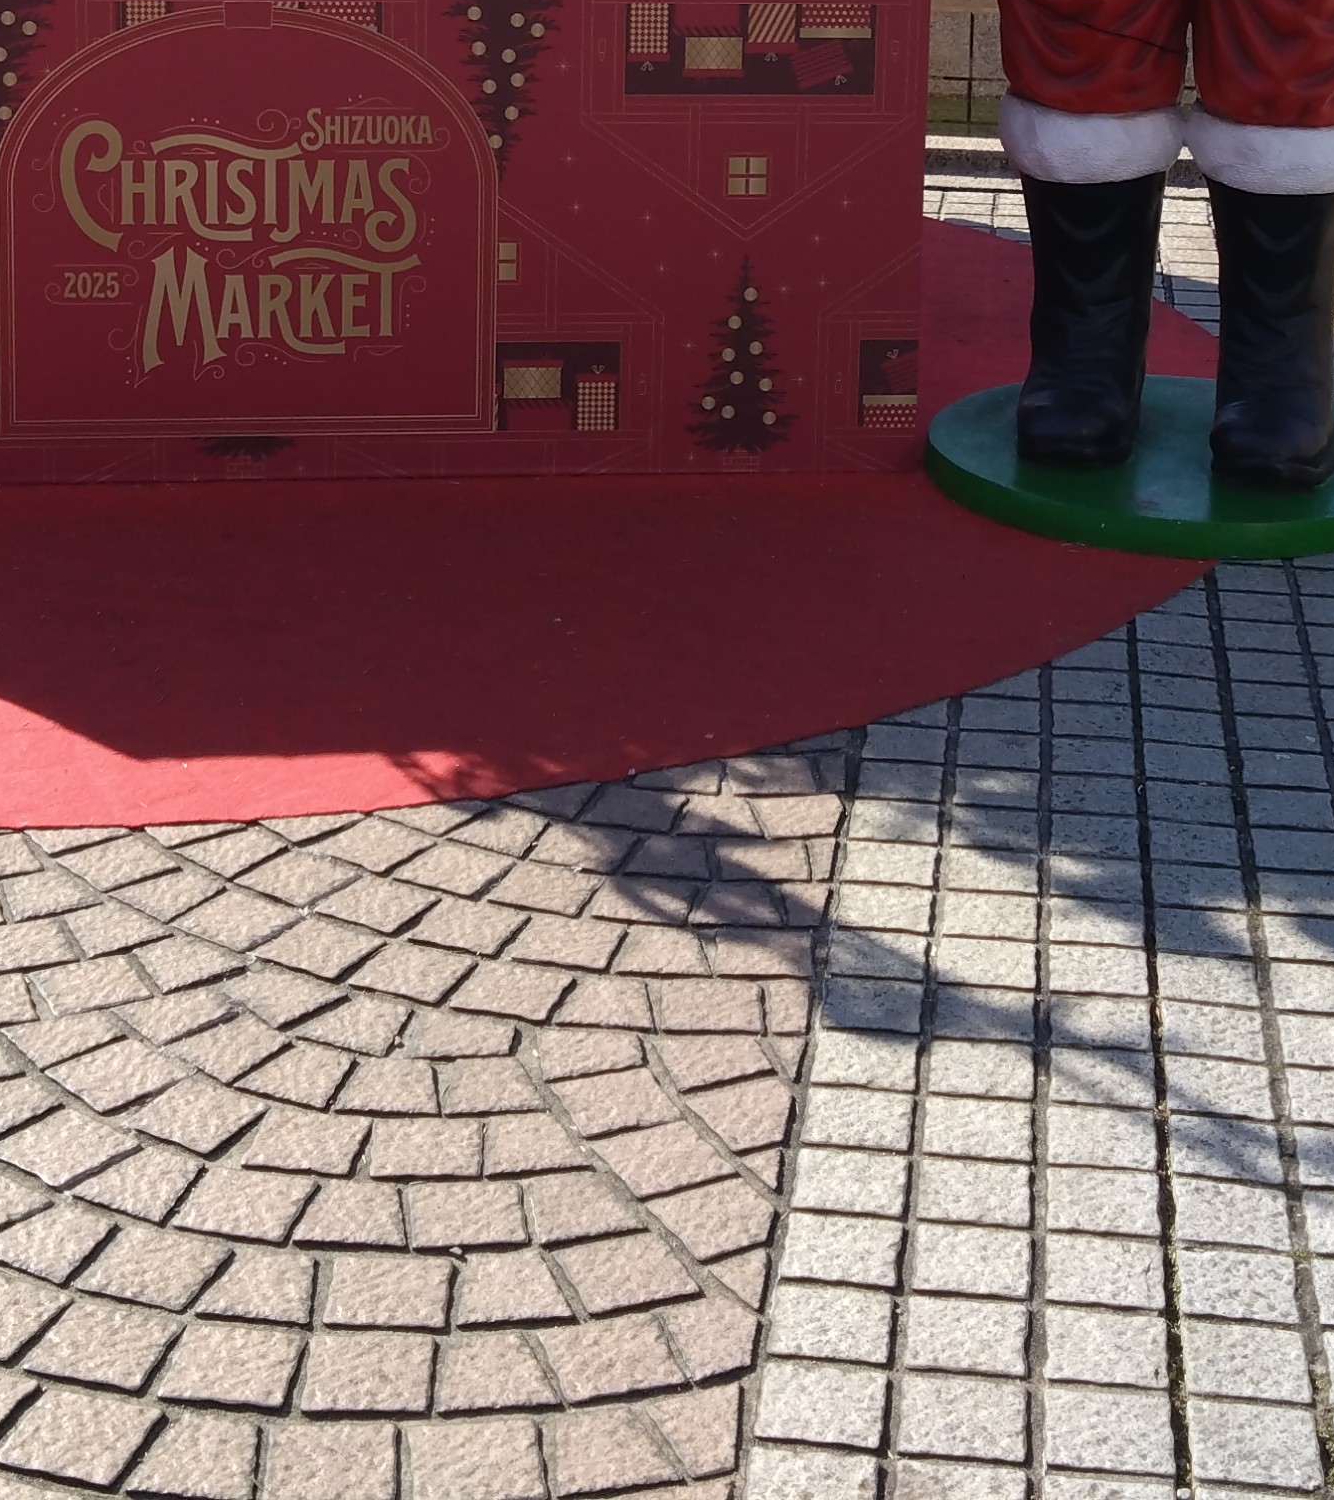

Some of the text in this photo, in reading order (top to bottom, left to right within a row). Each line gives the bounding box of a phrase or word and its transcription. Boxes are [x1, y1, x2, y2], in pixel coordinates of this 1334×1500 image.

[300, 107, 434, 151] SHIZUOKA
[59, 120, 418, 253] CHRISTMAS
[63, 271, 120, 300] 2025
[142, 246, 422, 373] MARKET
